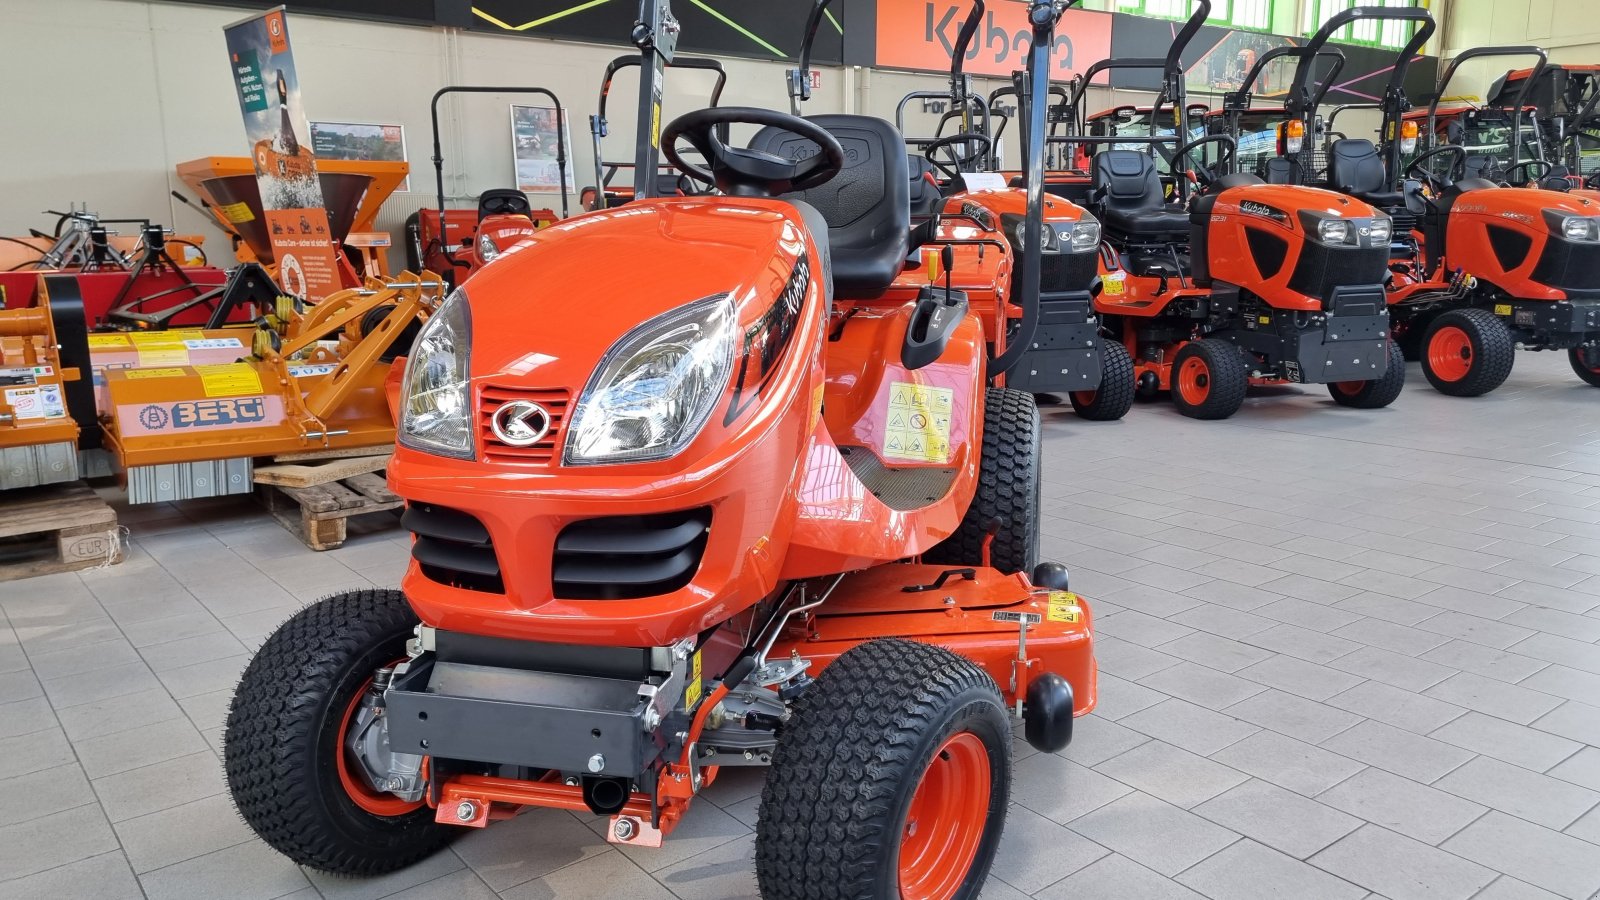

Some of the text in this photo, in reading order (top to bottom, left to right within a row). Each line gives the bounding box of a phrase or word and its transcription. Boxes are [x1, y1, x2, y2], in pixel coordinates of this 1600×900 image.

[925, 2, 1073, 70] Kuboa
[1243, 201, 1270, 215] Kubota
[785, 262, 810, 315] Kubota
[79, 540, 102, 555] EUR
